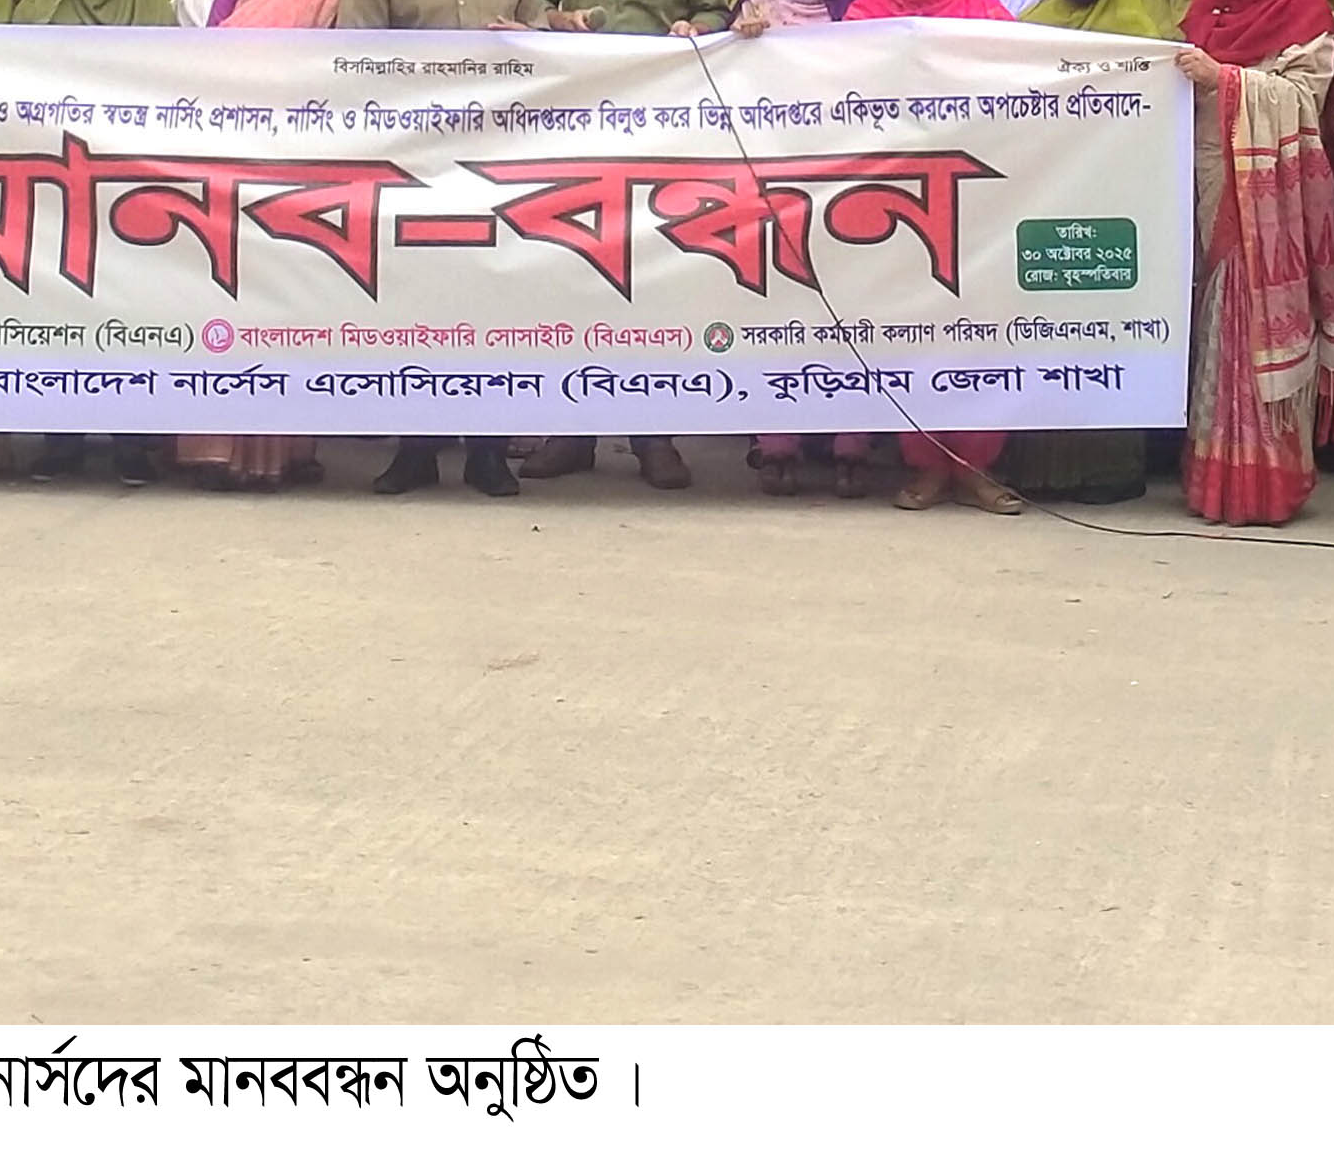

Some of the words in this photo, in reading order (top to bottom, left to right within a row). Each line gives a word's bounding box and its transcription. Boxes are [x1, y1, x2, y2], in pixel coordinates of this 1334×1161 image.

[333, 57, 416, 76] বিসমিল্লাহির
[422, 58, 487, 76] রাহমানির
[492, 59, 535, 77] রাহিম
[1057, 57, 1092, 74] ঐক্য
[1098, 62, 1111, 73] ও
[1117, 56, 1152, 73] শান্তি
[15, 95, 96, 127] অগ্রগতির
[101, 104, 150, 128] স্বতন্ত্র
[155, 96, 204, 132] নার্সিং
[209, 104, 279, 137] প্রশাসন,
[285, 98, 336, 135] নার্সিং
[342, 108, 357, 131] ও
[364, 99, 485, 135] মিডওয়াইফারি
[491, 100, 592, 134] অধিদপ্তরকে
[597, 99, 647, 136] বিলুপ্ত
[652, 105, 691, 131] করে
[697, 97, 734, 135] ভিন্ন
[738, 96, 822, 131] অধিদপ্তরে
[830, 90, 900, 133] একিভূত
[906, 94, 971, 125] করনের
[976, 87, 1061, 122] অপচেষ্টার
[1065, 85, 1152, 122] প্রতিবাদে-
[1055, 222, 1098, 239] তারিখ:
[1021, 249, 1042, 260] ৩০
[1045, 245, 1091, 261] অক্টোবর
[1096, 247, 1133, 262] ২০২৫
[1025, 269, 1058, 283] রোজ:
[1061, 264, 1133, 287] বৃহস্পতিবার
[94, 318, 196, 353] (বিএনএ)
[238, 325, 333, 348] বাংলাদেশ
[340, 322, 477, 349] মিডওয়াইফারি
[484, 322, 575, 349] সোসাইটি
[583, 322, 693, 353] (বিএমএস)
[740, 320, 806, 347] সরকারি
[811, 318, 875, 345] কর্মচারী
[881, 321, 935, 344] কল্যাণ
[942, 317, 999, 344] পরিষদ
[1005, 315, 1117, 346] (ডিজিএনএম,
[1122, 316, 1170, 344] শাখা)
[169, 364, 292, 398] নার্সেস
[305, 365, 547, 399] এসোসিয়েশন
[561, 365, 749, 404] (বিএনএ),
[762, 364, 915, 403] কুড়িগ্রাম
[930, 364, 1027, 394] জেলা
[1038, 362, 1126, 392] শাখা
